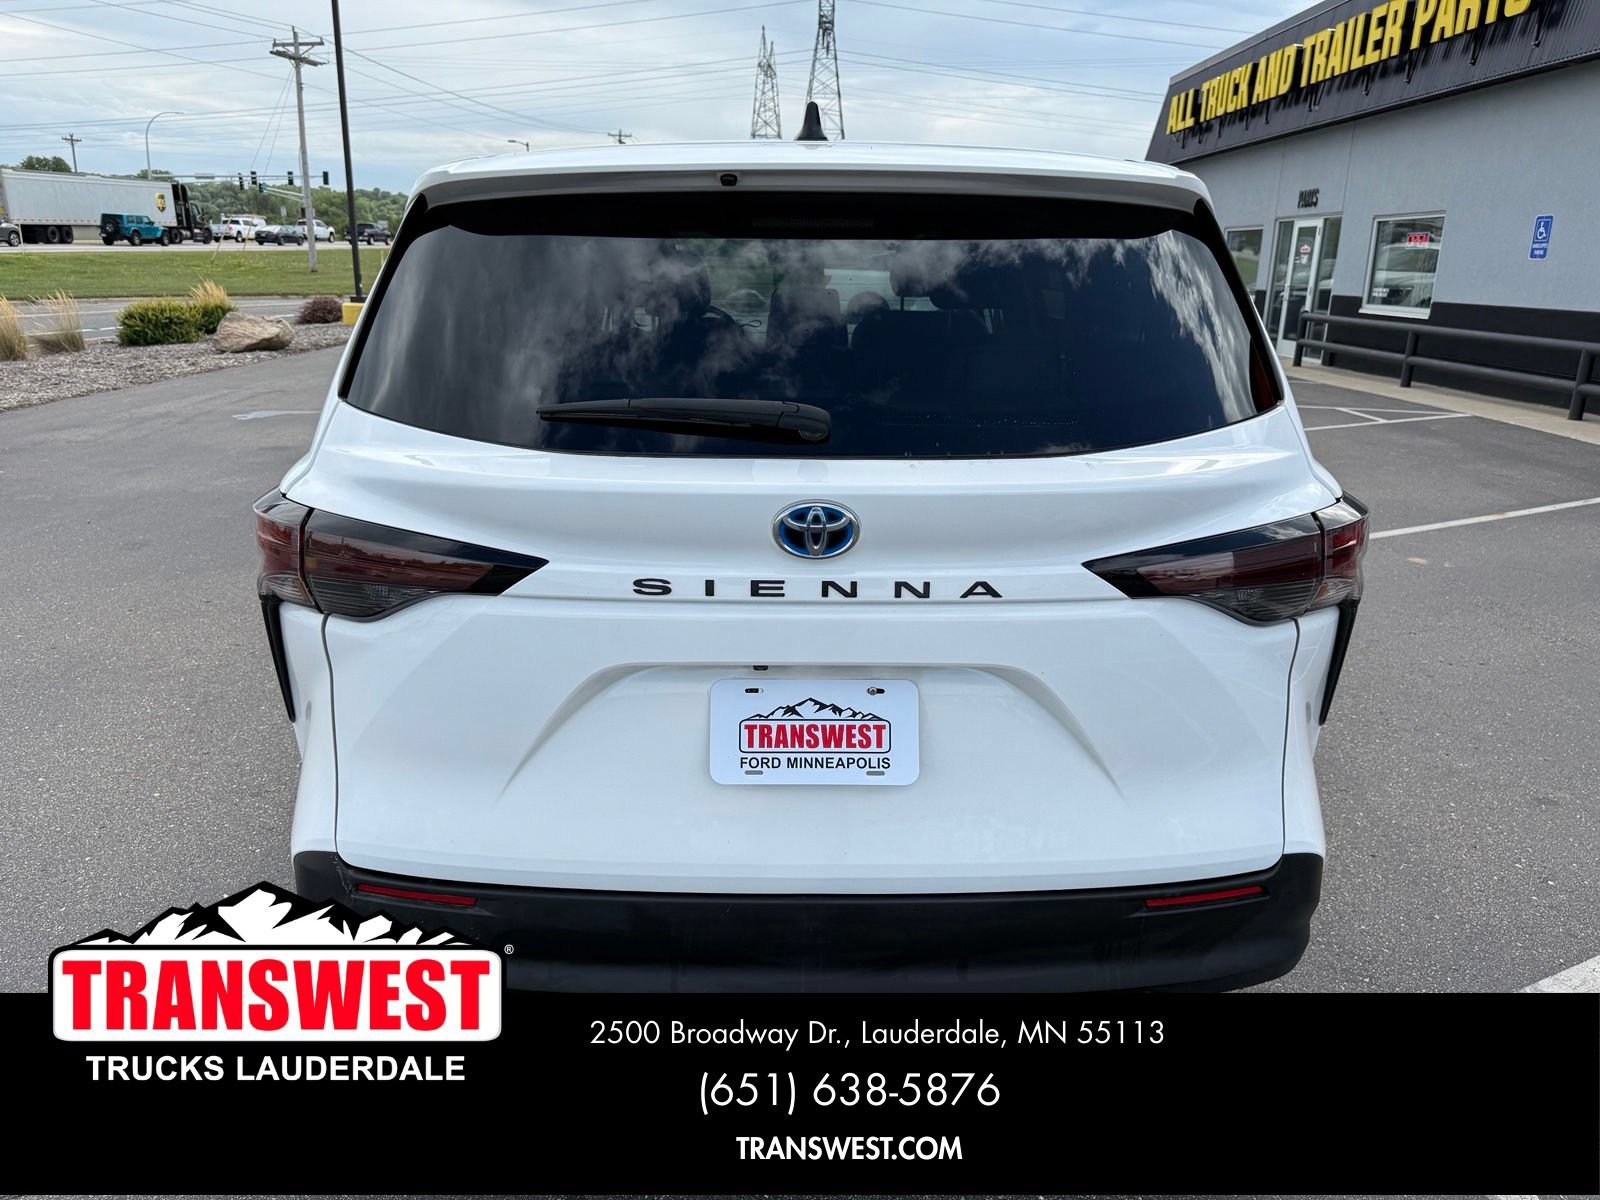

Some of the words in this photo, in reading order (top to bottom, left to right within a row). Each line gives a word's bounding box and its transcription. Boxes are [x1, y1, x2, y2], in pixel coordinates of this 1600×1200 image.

[1166, 88, 1195, 135] ALL
[1200, 61, 1253, 123] TRUCK
[1251, 44, 1298, 105] AND
[1300, 0, 1408, 88] TRAILER
[1409, 0, 1531, 50] PAR
[632, 578, 1003, 599] SIENNA
[744, 723, 886, 750] TRANSWEST
[740, 757, 782, 769] FORD
[786, 757, 891, 770] MINNEAPOLIS
